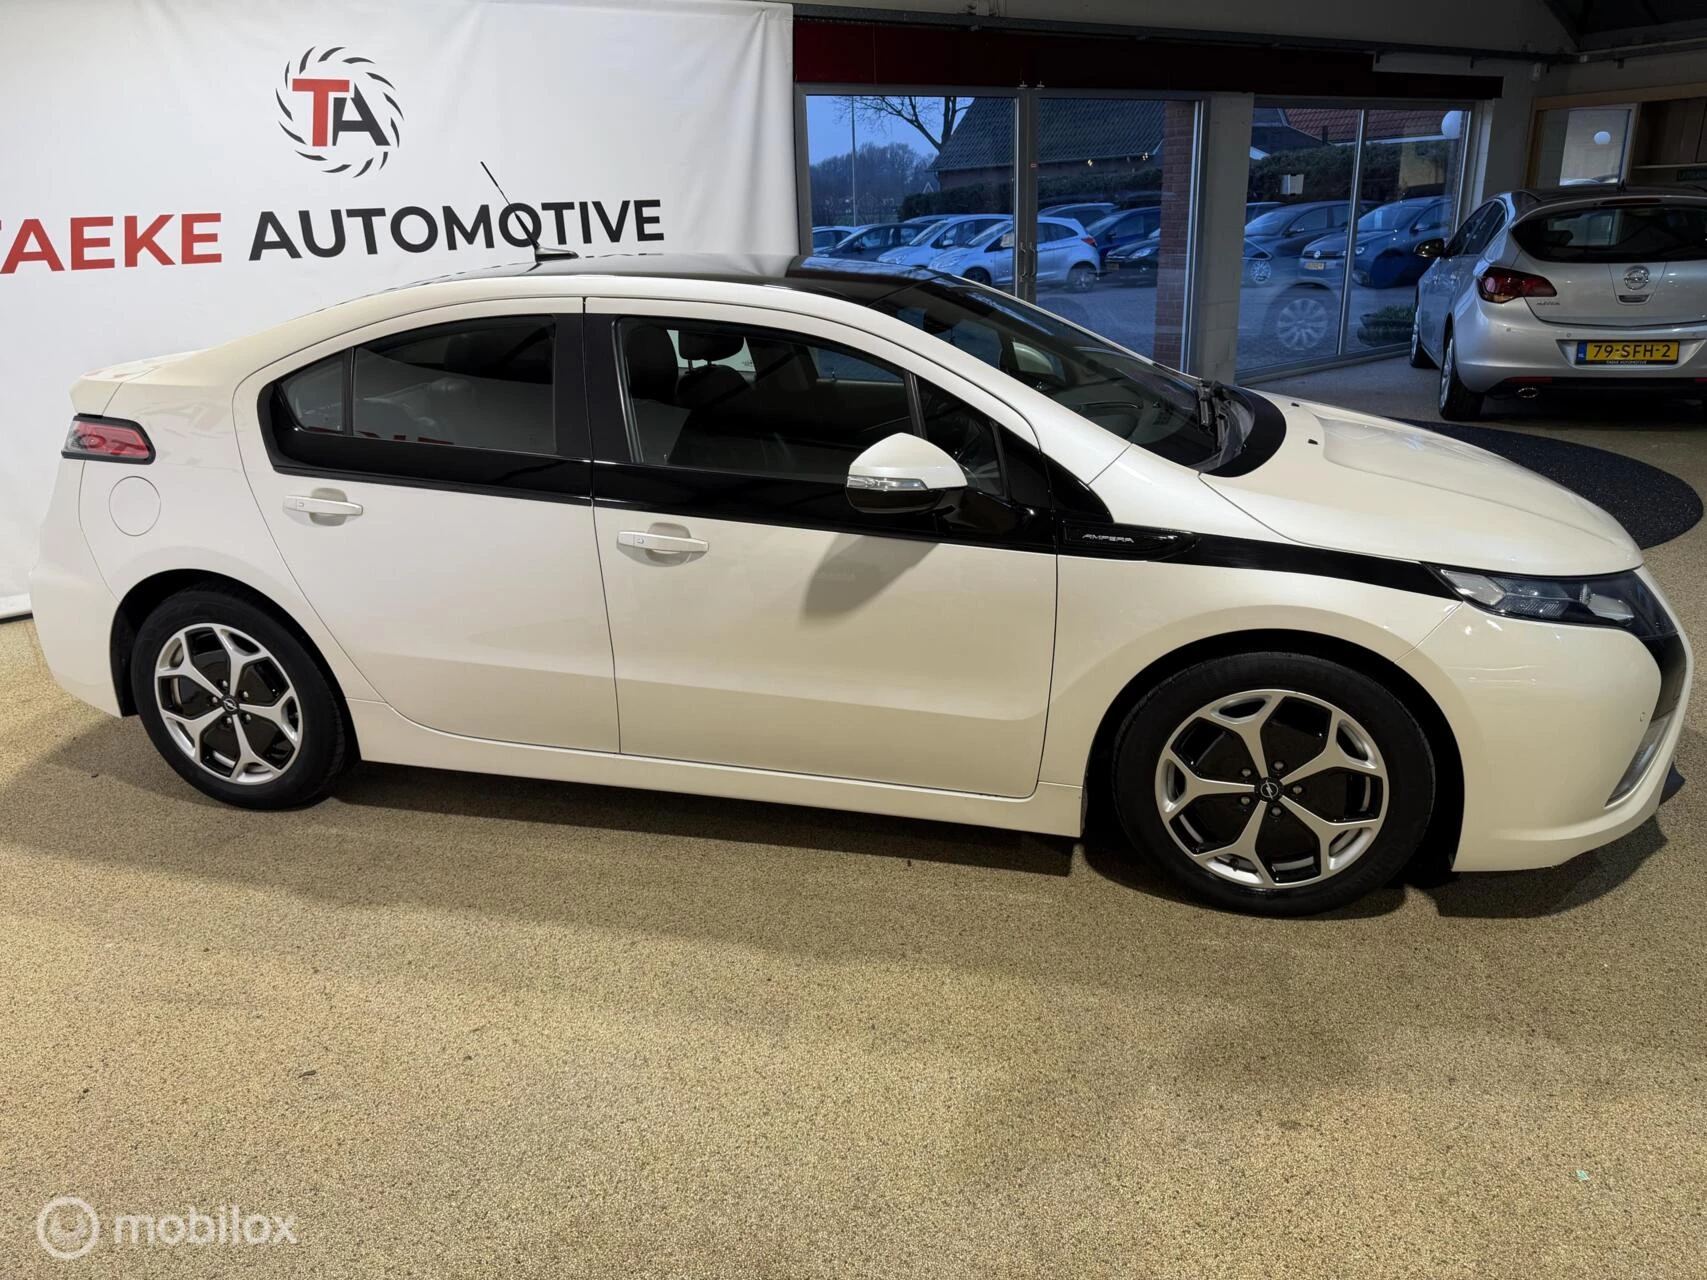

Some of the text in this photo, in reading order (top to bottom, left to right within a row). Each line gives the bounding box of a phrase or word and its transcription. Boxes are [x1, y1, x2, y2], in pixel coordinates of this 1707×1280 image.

[293, 80, 390, 147] TA
[0, 199, 664, 274] AEKE AUTOMOTIVE
[1593, 344, 1671, 358] 79-SFH-2
